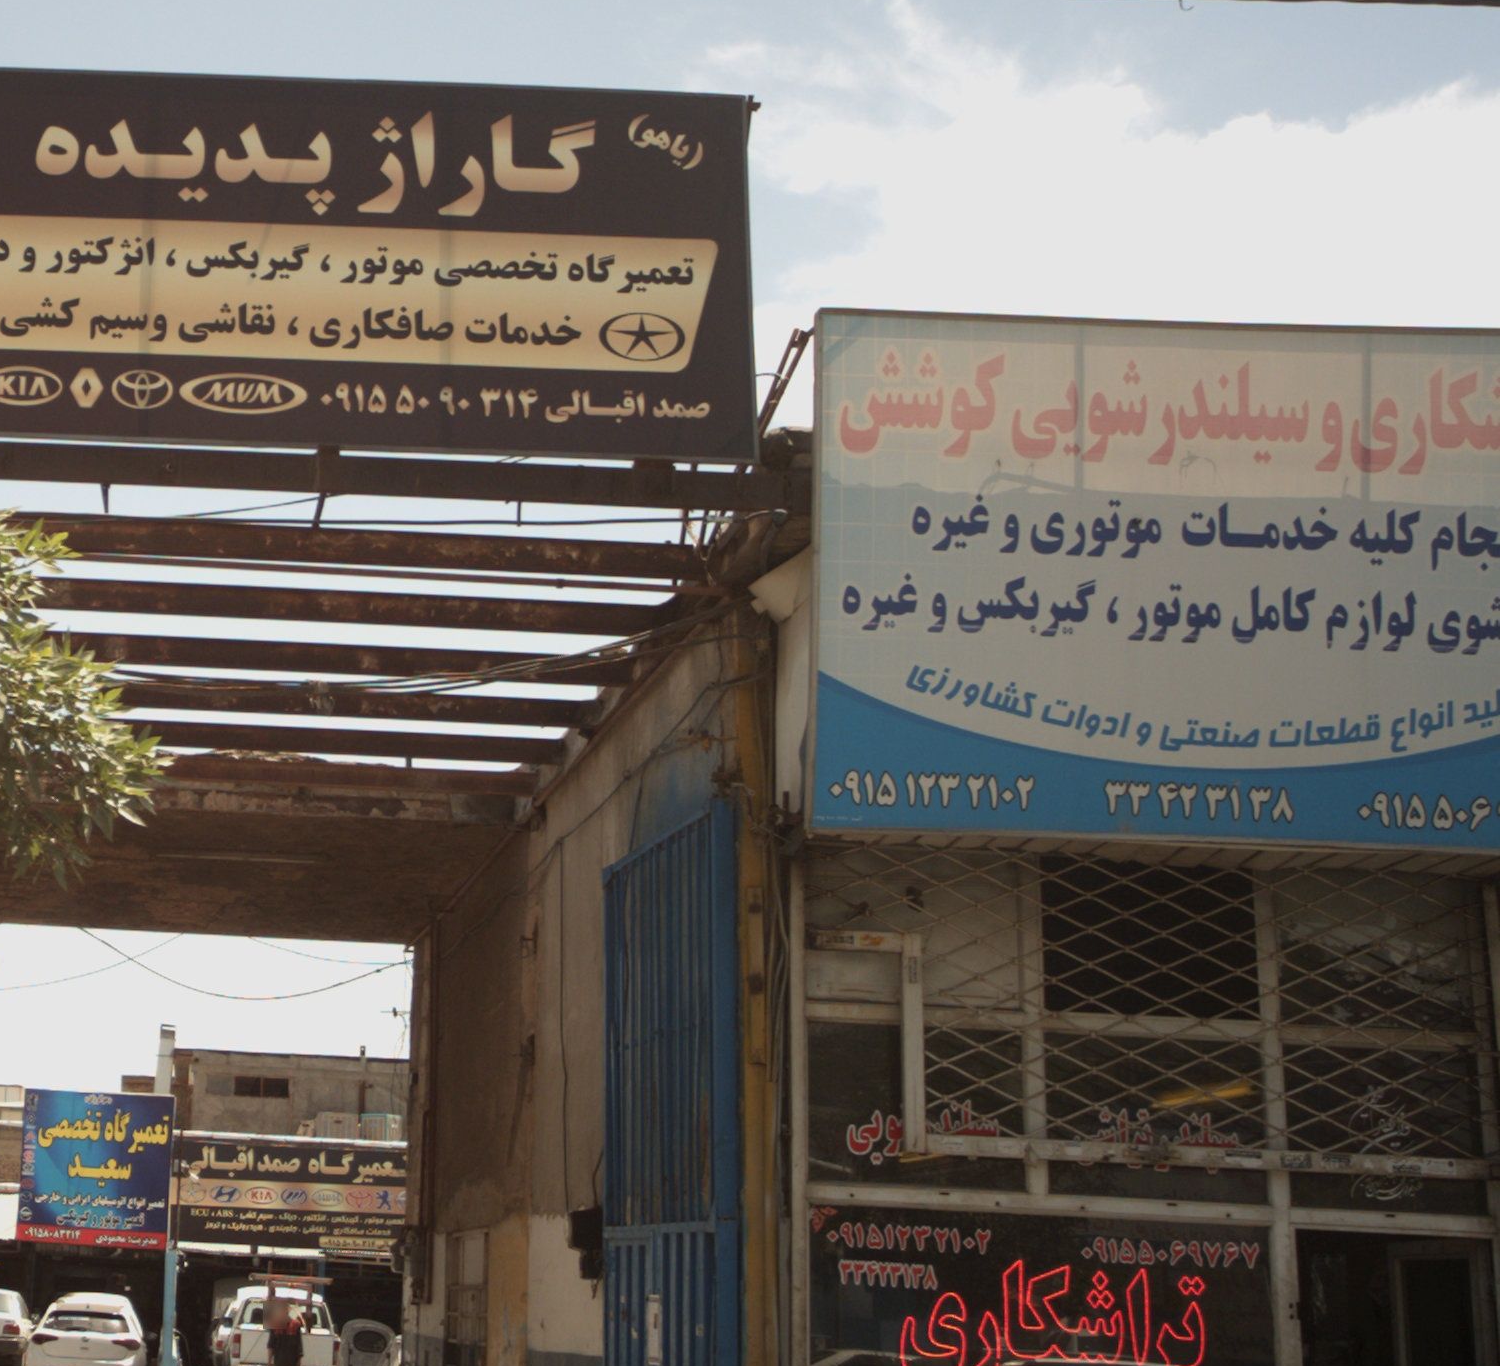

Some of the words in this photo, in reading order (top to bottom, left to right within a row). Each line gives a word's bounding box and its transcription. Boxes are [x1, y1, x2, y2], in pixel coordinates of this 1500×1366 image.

[36, 119, 336, 216] پدیده
[357, 110, 597, 217] گاراژ
[18, 246, 36, 272] و
[46, 236, 155, 275] انژکتور
[186, 241, 309, 281] گیربکس
[341, 247, 424, 284] موتور
[434, 252, 558, 287] تخصصی
[0, 297, 81, 337] کشی
[179, 303, 276, 343] نقاشی
[310, 307, 454, 349] صافکاری
[465, 312, 582, 346] خدمات
[545, 389, 646, 423] اقبالی
[653, 396, 711, 419] صمد
[840, 351, 1005, 457] کوشش
[912, 494, 990, 551] غیره
[1000, 514, 1020, 553] و
[1030, 499, 1162, 558] موتوری
[1182, 502, 1339, 550] خدمات
[1350, 509, 1421, 565] کلیه
[842, 573, 918, 631] غیره
[927, 593, 947, 632] و
[958, 576, 1097, 637] گیربکس
[1128, 584, 1222, 643] موتور
[1232, 585, 1316, 643] کامل
[1326, 590, 1417, 651] لوازم
[905, 665, 1038, 719] کشاورزی
[1041, 699, 1132, 738] ادوات
[1136, 722, 1152, 746] و
[1159, 720, 1261, 752] صنعتی
[1269, 714, 1381, 748] قطعات
[1390, 701, 1454, 753] انواع
[37, 1110, 102, 1148] تخصصی
[67, 1154, 132, 1188] سعید
[257, 1153, 301, 1174] صمد
